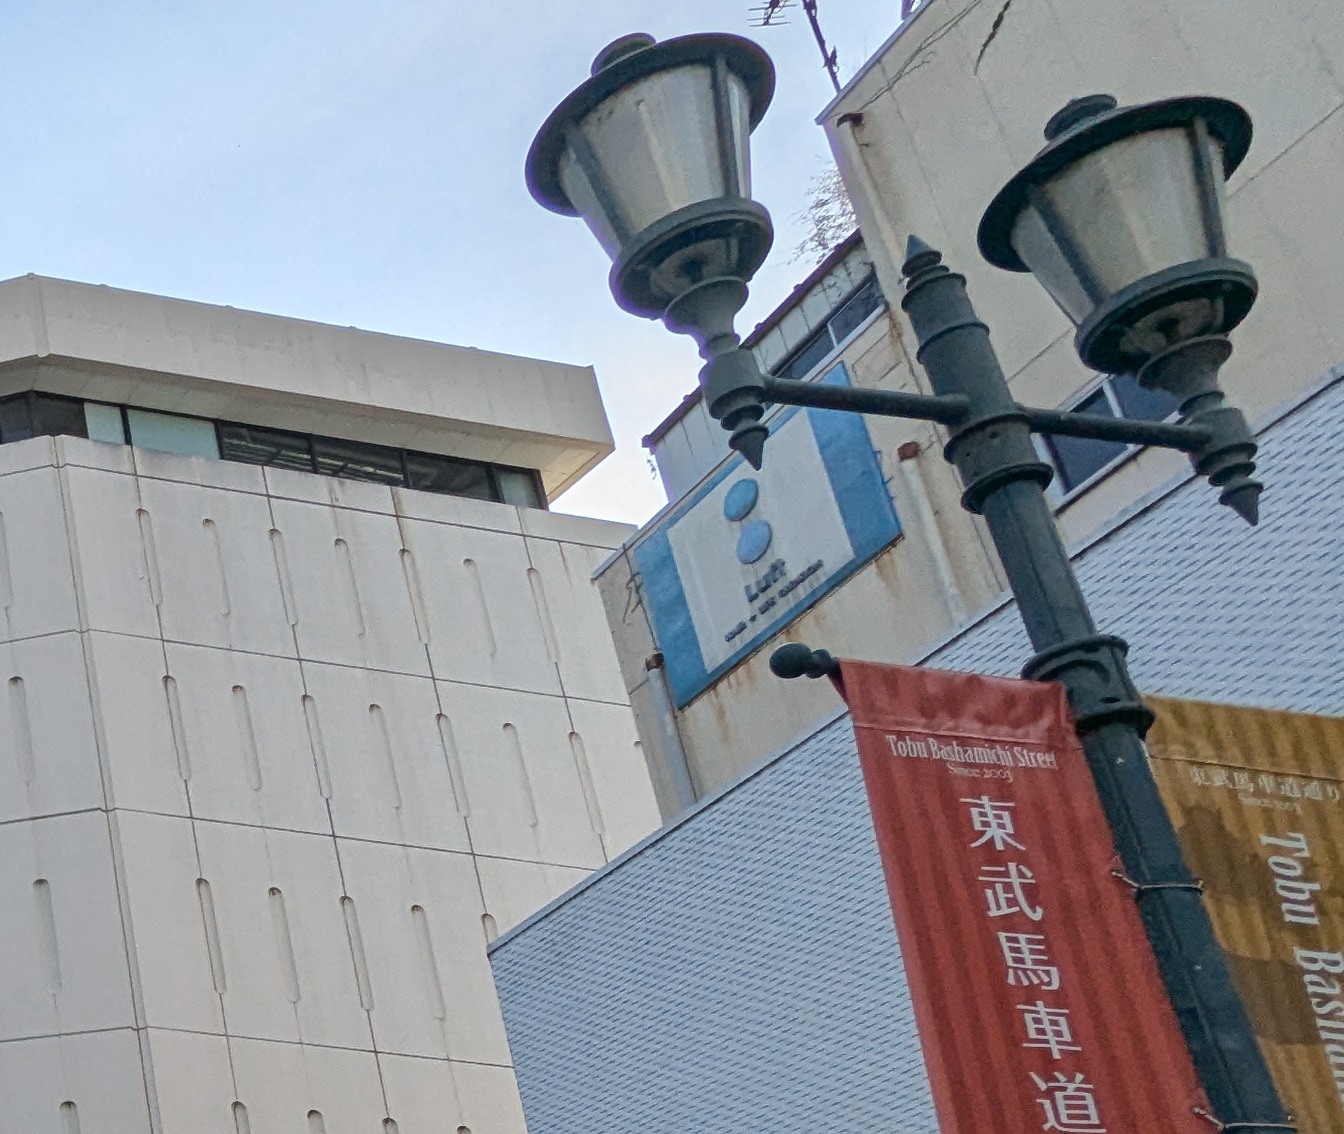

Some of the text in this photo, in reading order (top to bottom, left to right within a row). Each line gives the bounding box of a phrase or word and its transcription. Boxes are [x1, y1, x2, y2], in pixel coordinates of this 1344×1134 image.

[885, 734, 1059, 770] Tobu Bashamichi Street
[1260, 832, 1322, 927] Tobu
